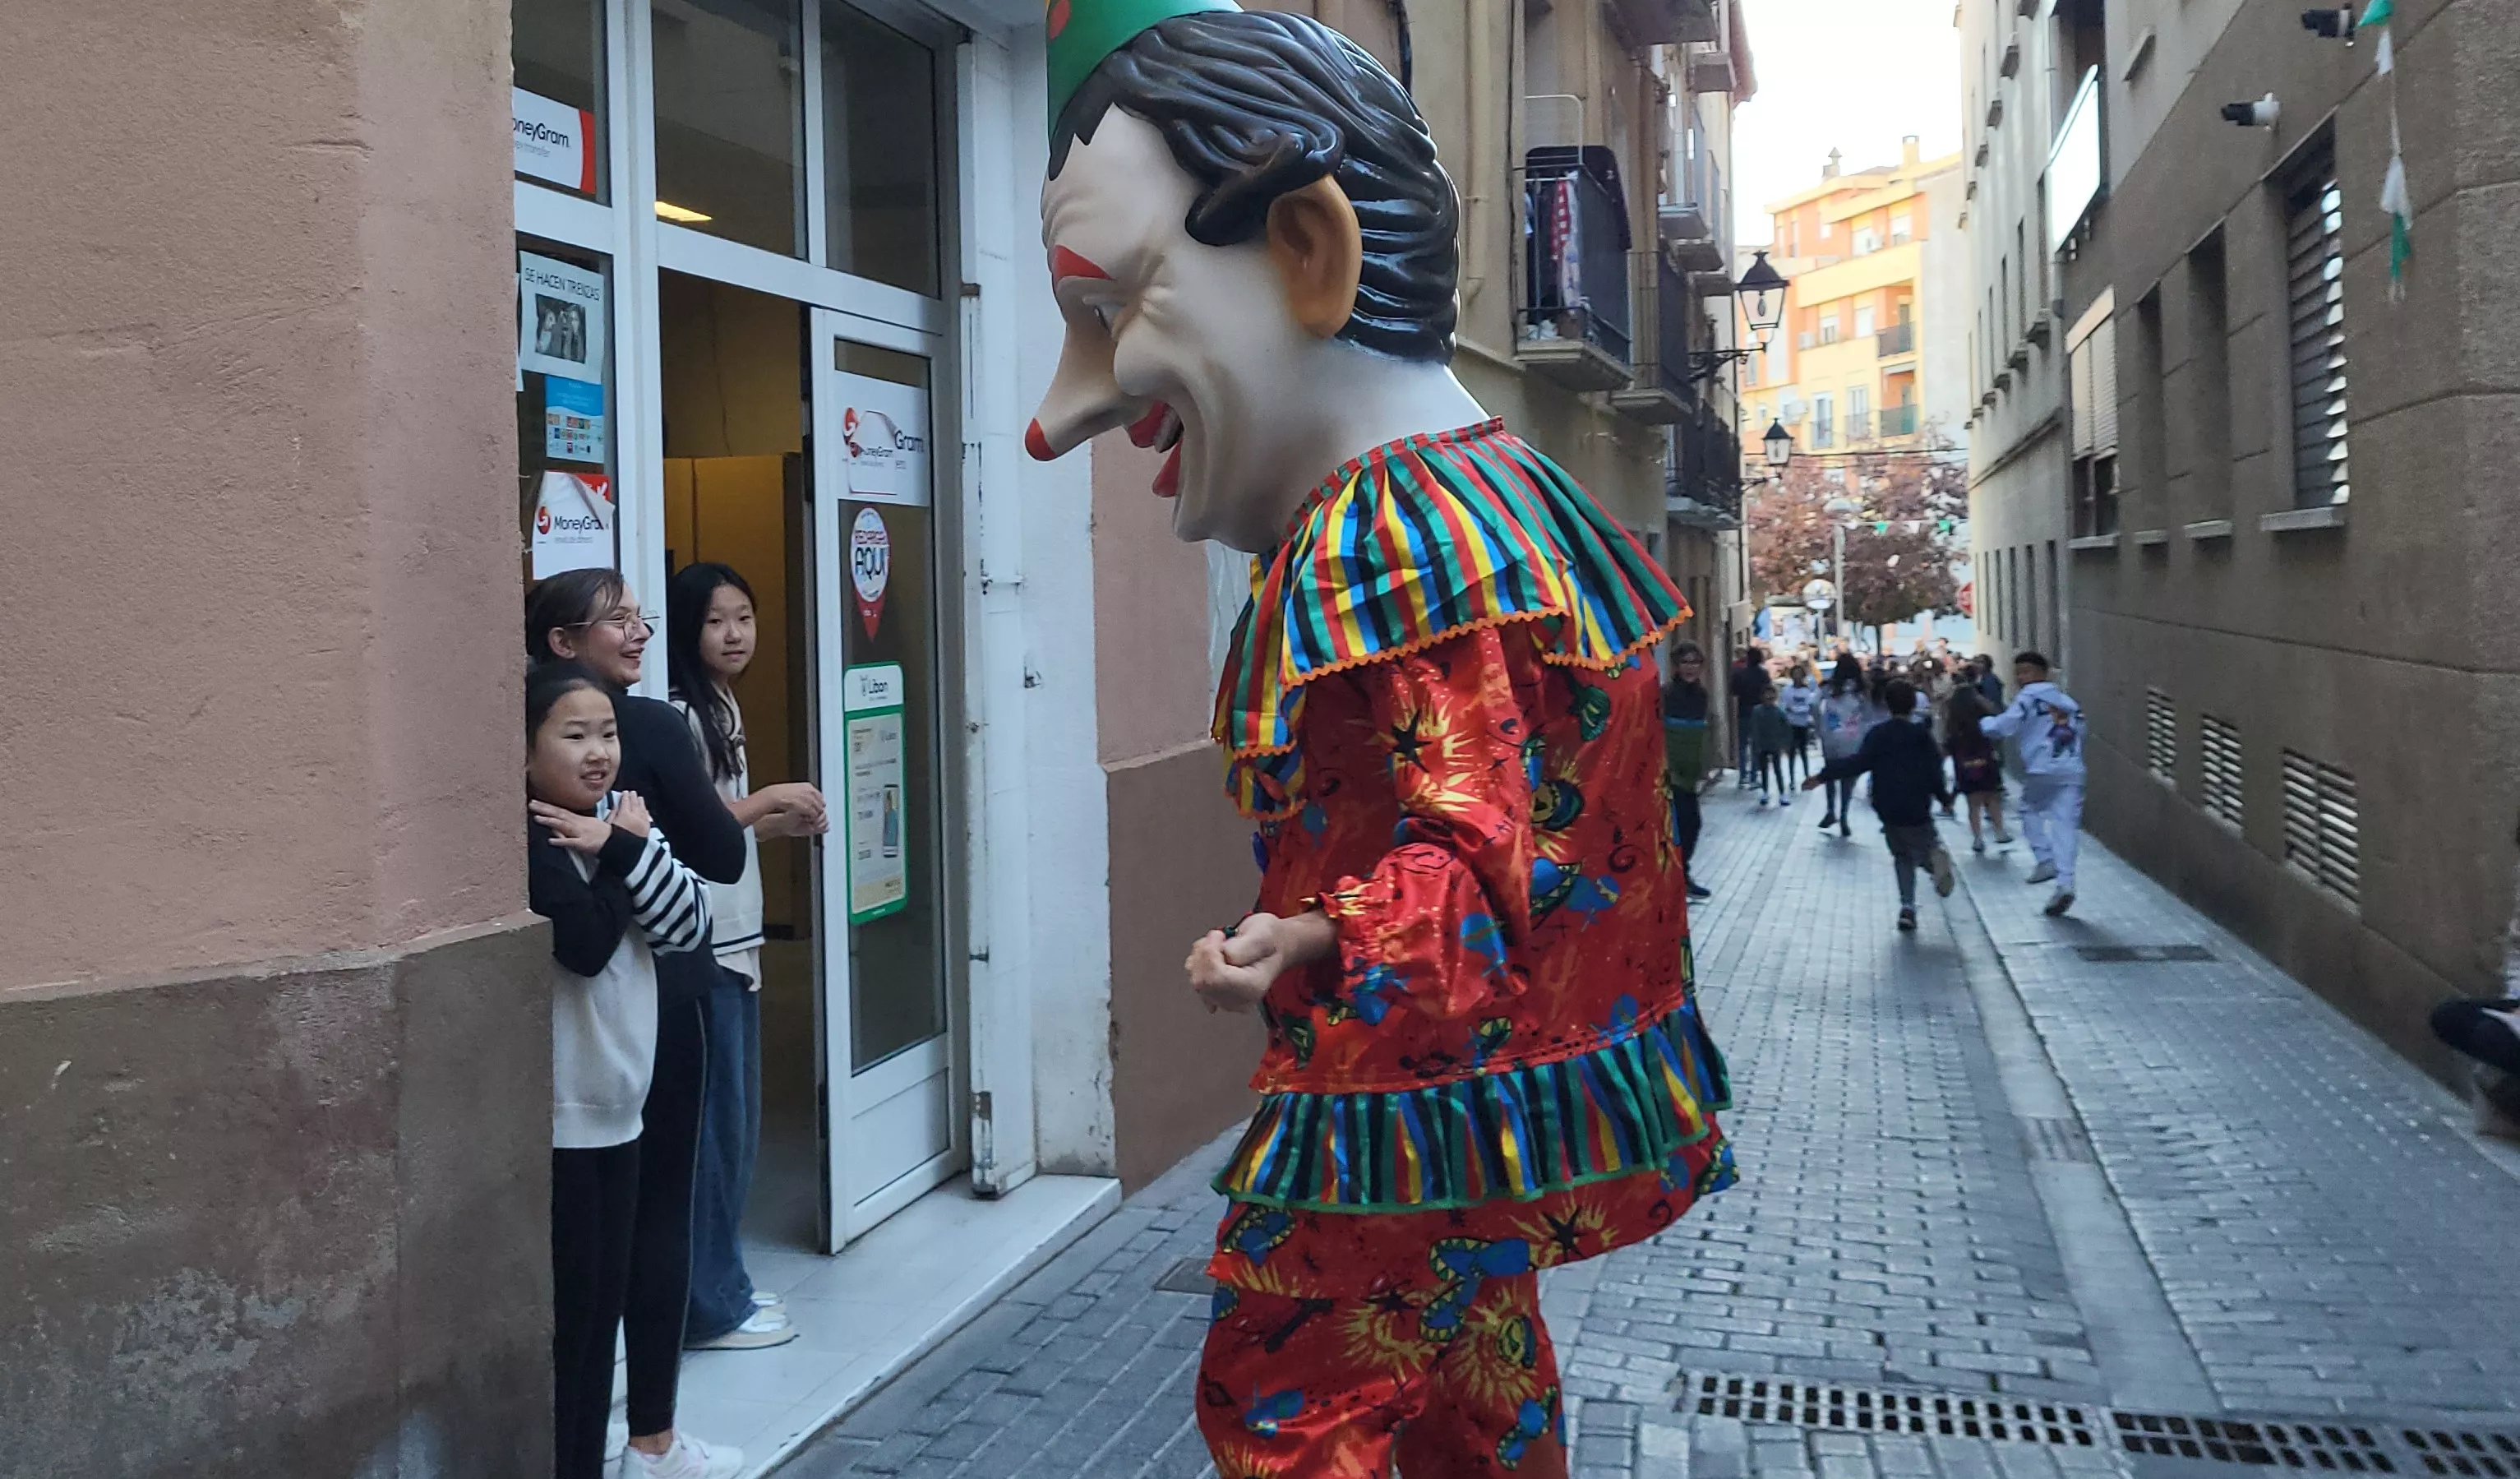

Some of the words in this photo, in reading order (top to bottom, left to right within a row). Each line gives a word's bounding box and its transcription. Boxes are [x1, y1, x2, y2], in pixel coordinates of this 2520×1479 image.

[512, 118, 570, 148] oneyGram
[525, 267, 535, 283] SE
[537, 270, 565, 290] HACEN
[567, 279, 600, 302] TRENZAS
[554, 515, 609, 534] MoneyGra
